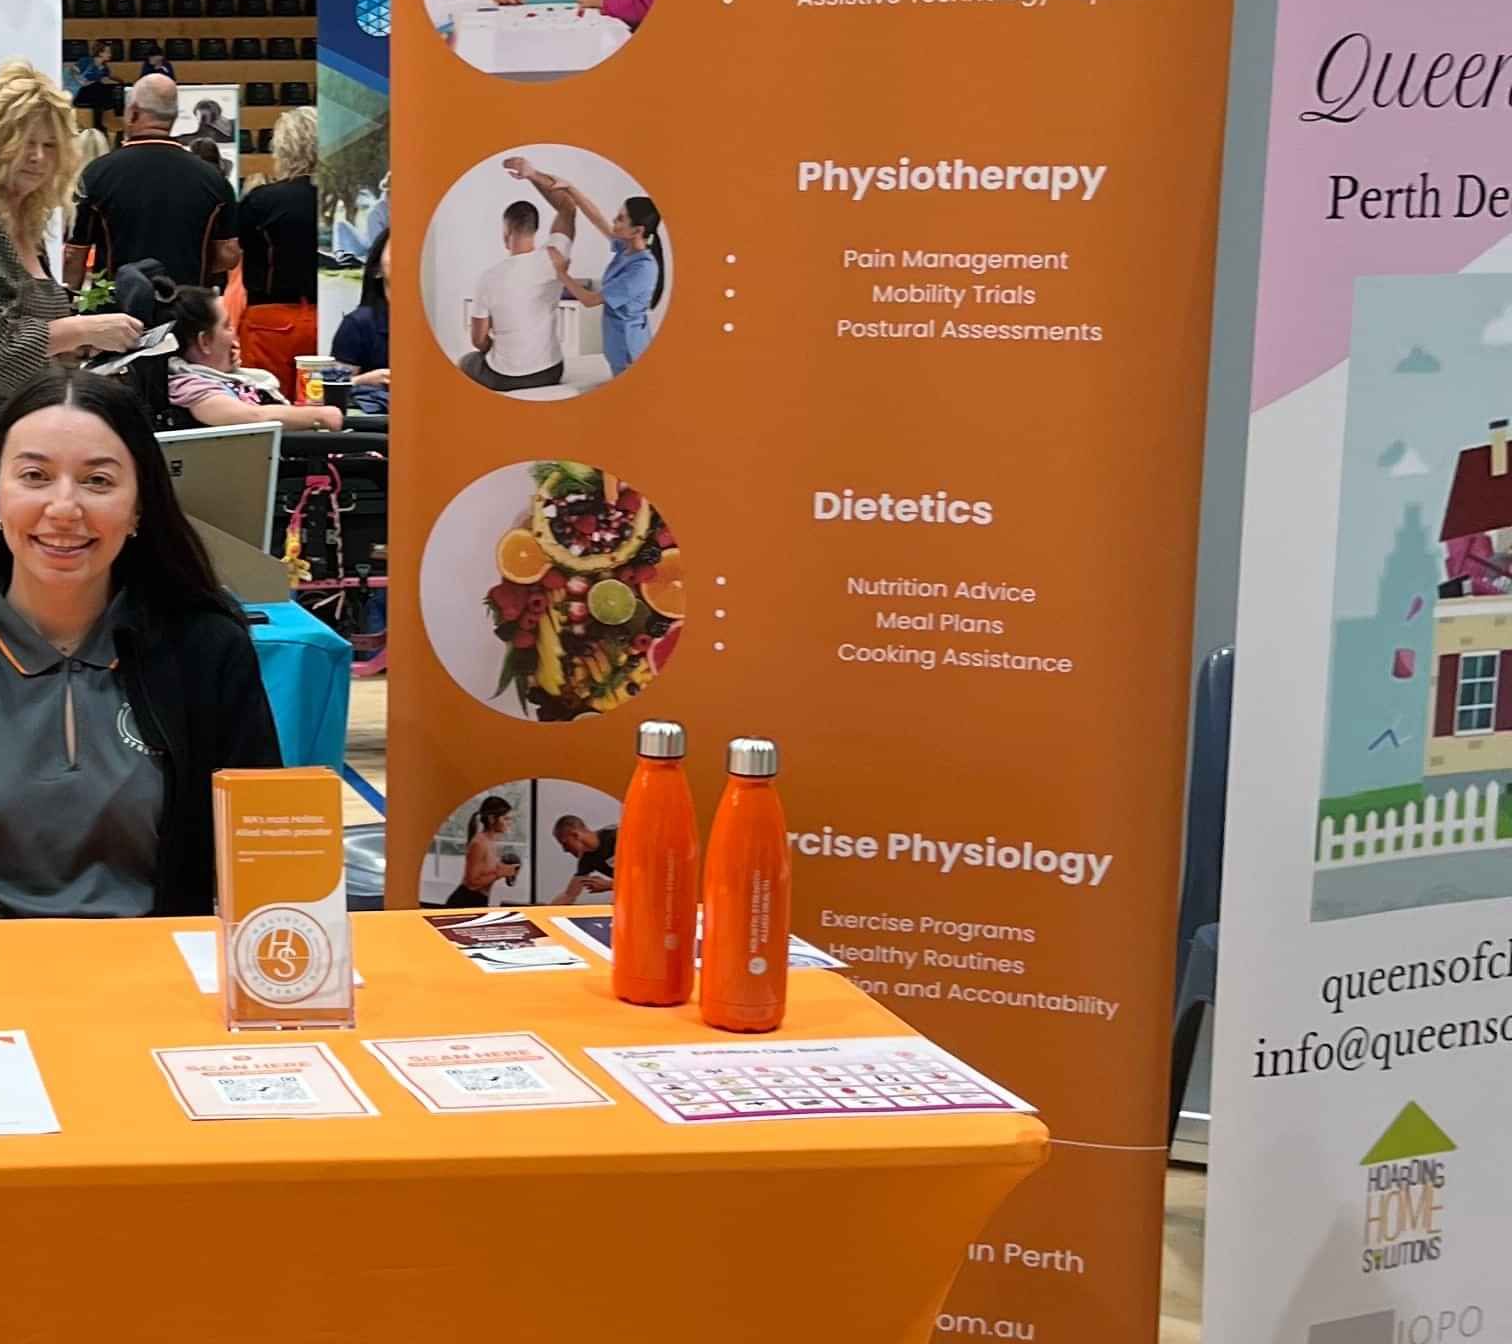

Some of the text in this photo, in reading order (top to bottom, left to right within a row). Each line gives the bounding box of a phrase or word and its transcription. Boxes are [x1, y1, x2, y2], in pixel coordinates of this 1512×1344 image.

[797, 157, 1108, 201] Physiotherapy
[1325, 172, 1512, 220] Perth De
[843, 249, 1069, 275] Pain Management
[872, 283, 1037, 309] Mobility Trials
[837, 318, 1104, 342] Postural Assessments
[813, 489, 994, 526] Dietetics
[847, 576, 1037, 603] Nutrition Advice
[876, 611, 1005, 635] Meal Plans
[838, 642, 1074, 674] Cooking Assistance
[786, 826, 1113, 887] rcise Physiology
[821, 909, 1037, 944] Exercise Programs
[829, 942, 1026, 975] Healthy Routines
[893, 980, 942, 1001] and
[947, 982, 1120, 1021] Accountability
[1252, 1014, 1512, 1078] info@queenso
[185, 1063, 250, 1072] SCAN
[1003, 1242, 1085, 1274] Perth
[936, 1313, 1035, 1341] om.au
